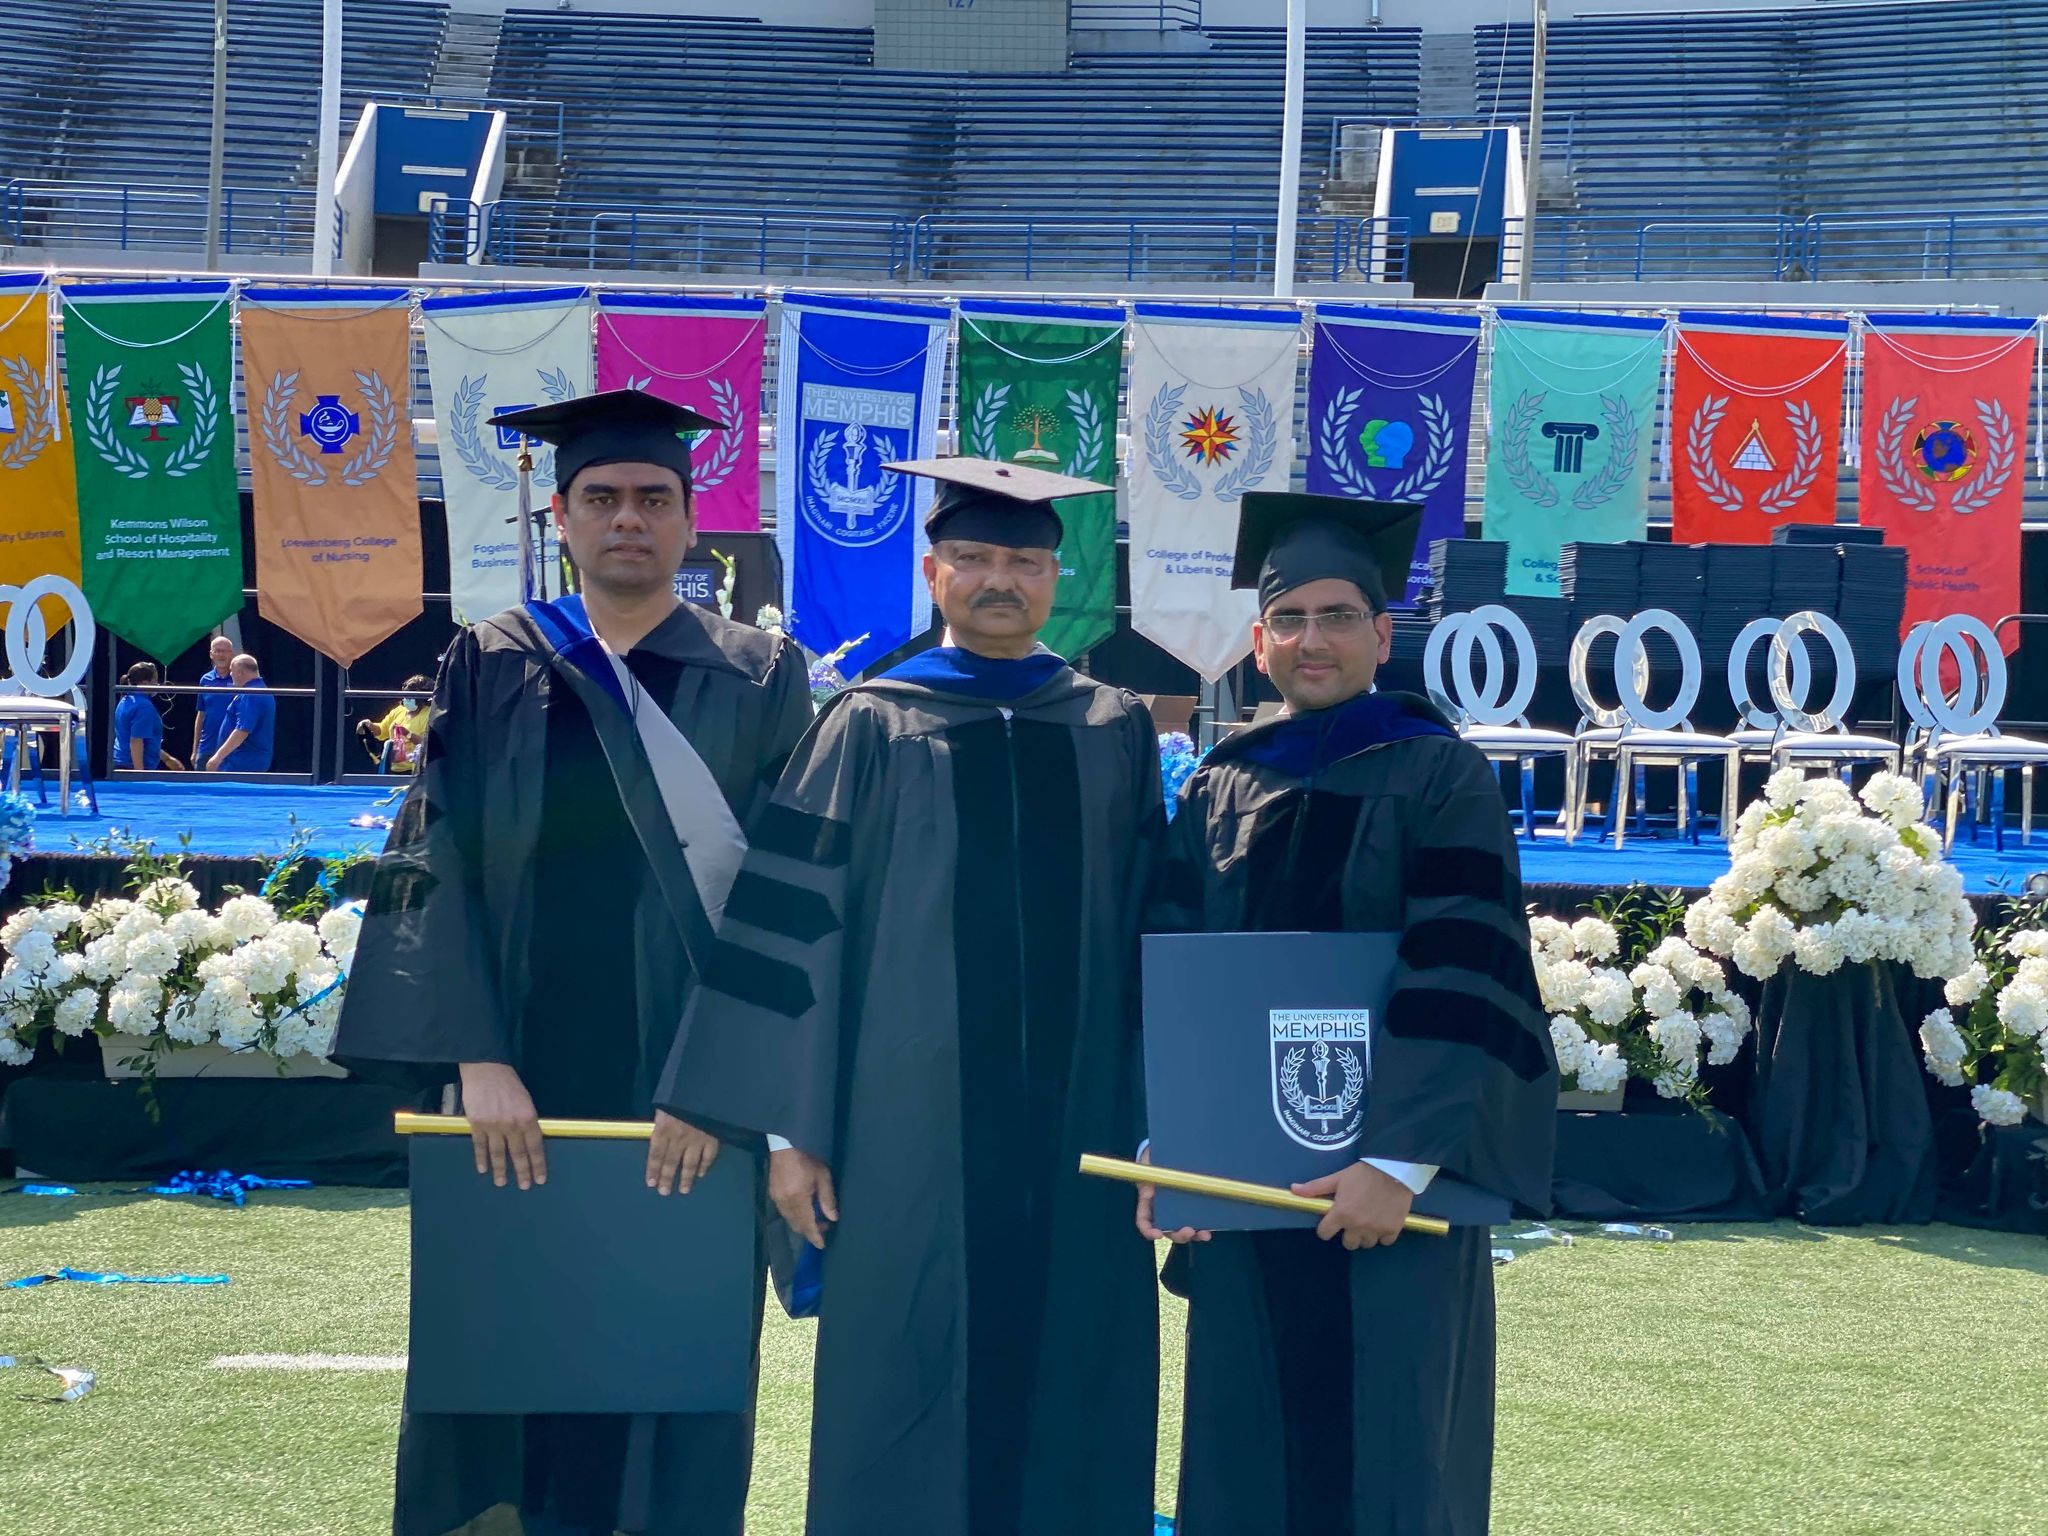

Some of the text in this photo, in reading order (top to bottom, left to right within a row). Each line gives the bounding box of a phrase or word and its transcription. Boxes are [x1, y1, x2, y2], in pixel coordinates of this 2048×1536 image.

[805, 386, 913, 406] THE UNIVERSITY OF
[804, 398, 912, 426] MEMPHIS
[110, 518, 208, 529] Kemmons Wilson
[105, 532, 218, 545] School of Hospitality
[353, 537, 397, 548] College
[96, 547, 230, 560] and Resort Management
[312, 552, 370, 562] of Nursing
[1146, 549, 1233, 563] College of Profe
[1165, 564, 1233, 577] & Liberal Stu
[1522, 558, 1558, 571] Colleg
[695, 573, 709, 582] OF
[673, 582, 709, 598] PHIS
[1272, 1013, 1365, 1021] THE UNIVERSITY OF
[1273, 1022, 1366, 1038] MEMPHIS
